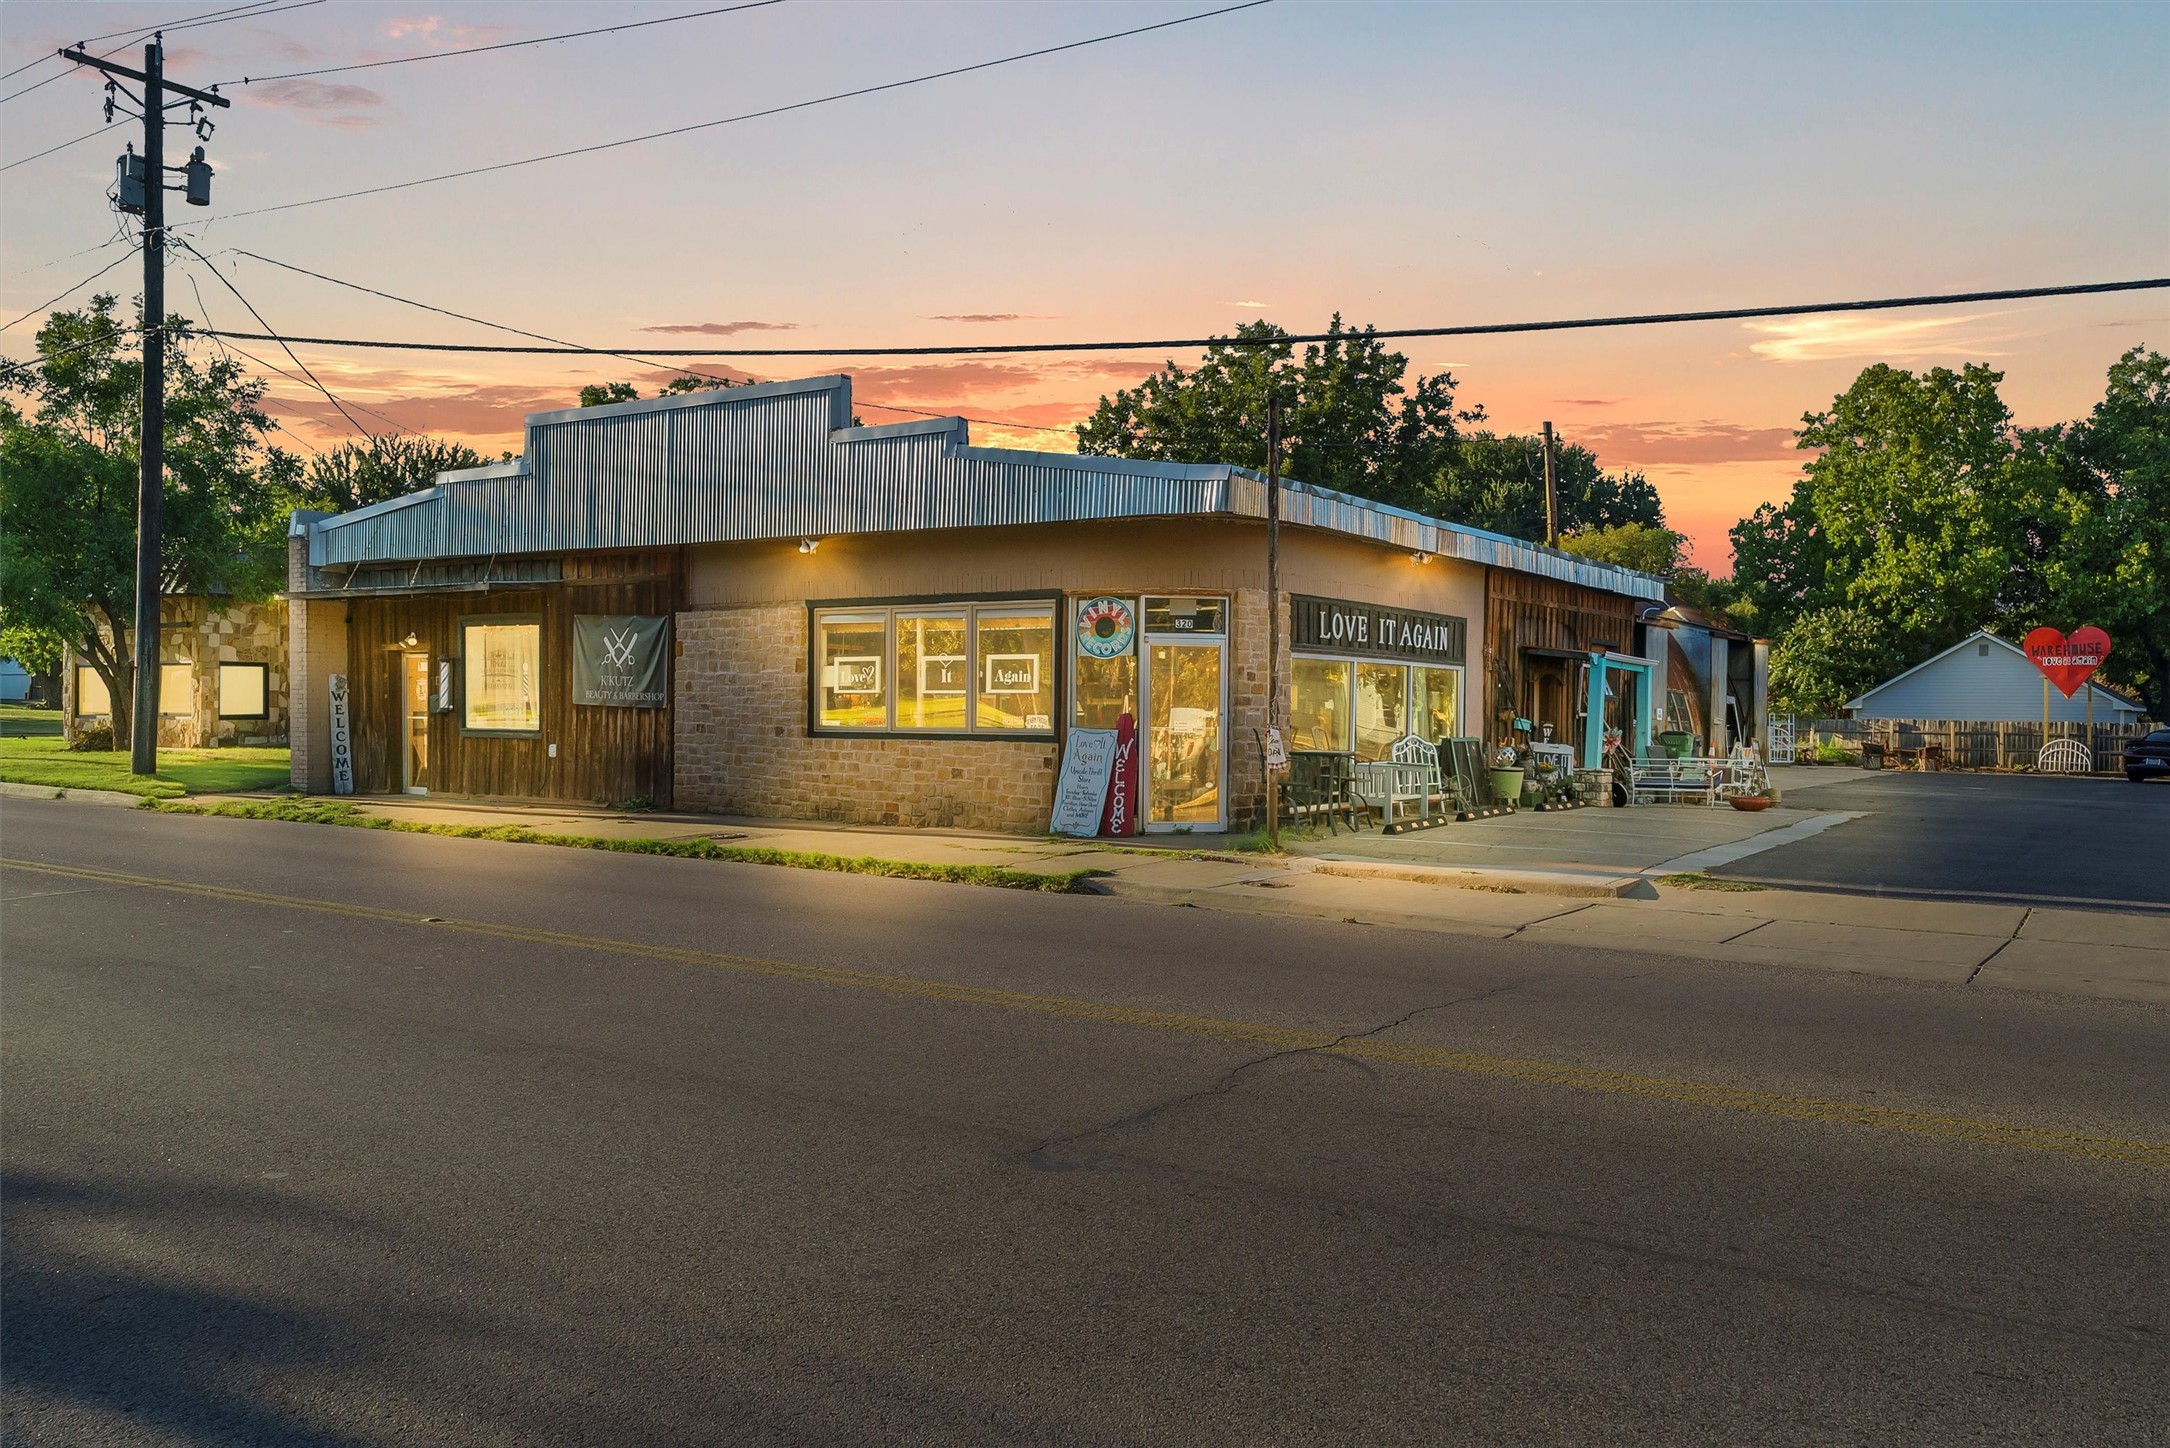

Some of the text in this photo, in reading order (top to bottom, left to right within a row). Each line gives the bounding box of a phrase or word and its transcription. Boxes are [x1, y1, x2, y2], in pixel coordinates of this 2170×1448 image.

[1079, 600, 1128, 629] VINYL
[1176, 619, 1193, 628] 320
[1080, 627, 1131, 655] RECORDS
[1319, 611, 1448, 651] LOVE IT AGAIN
[2031, 642, 2102, 657] WAREHOUSE
[841, 669, 1031, 685] Love It Again
[585, 690, 611, 699] BEAUTY
[619, 691, 665, 701] BARBERSHOP
[331, 691, 350, 781] WELCOME
[1073, 748, 1103, 766] Again
[1110, 738, 1134, 833] WELCOME
